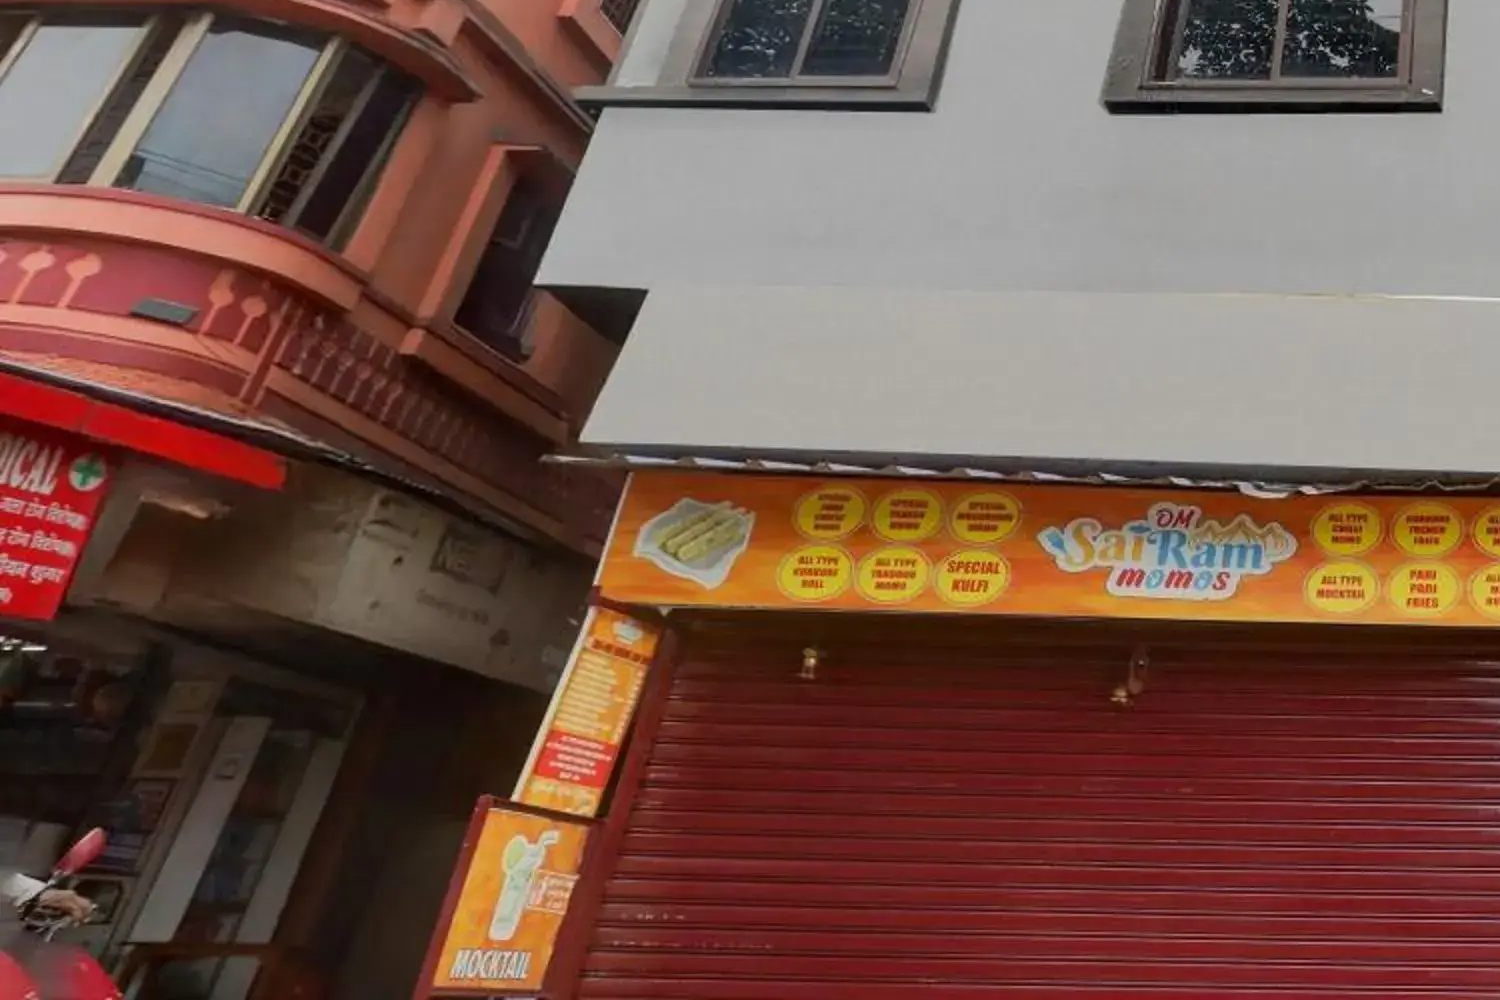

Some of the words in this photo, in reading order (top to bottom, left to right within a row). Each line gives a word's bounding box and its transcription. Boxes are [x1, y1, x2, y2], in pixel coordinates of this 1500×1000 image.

[1156, 509, 1195, 529] OM
[1147, 529, 1263, 570] Ram
[946, 560, 1001, 575] SPECIAL
[951, 579, 989, 593] KULFI
[1116, 568, 1230, 592] momos
[1320, 576, 1337, 585] ALL
[1340, 576, 1363, 586] TYPE
[448, 949, 532, 980] MOCKTAIL
